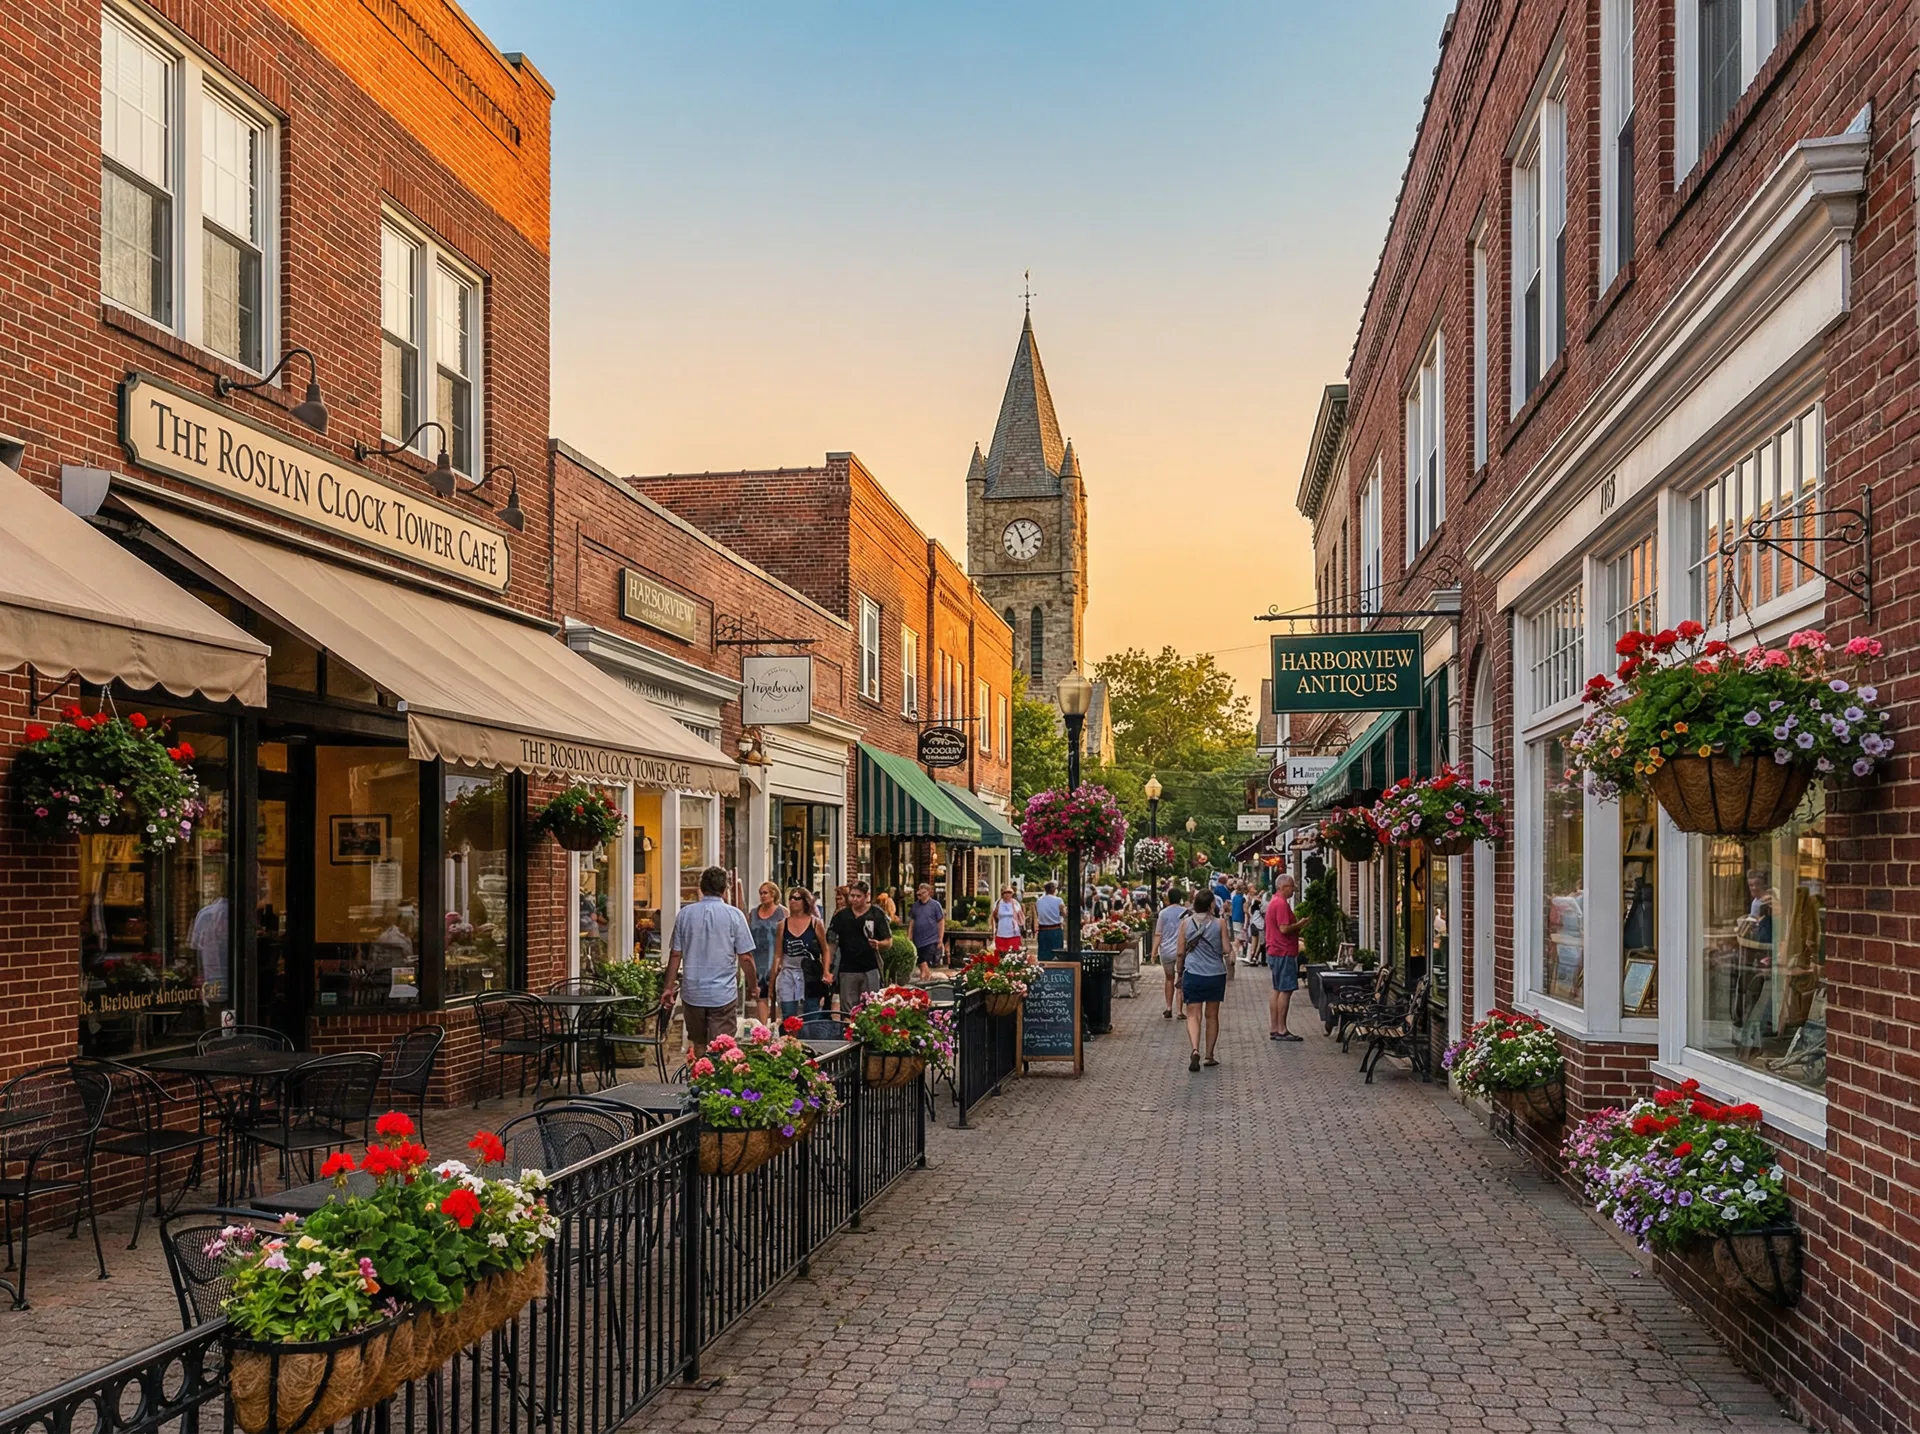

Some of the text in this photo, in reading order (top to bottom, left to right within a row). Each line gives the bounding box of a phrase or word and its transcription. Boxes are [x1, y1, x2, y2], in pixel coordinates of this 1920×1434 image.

[150, 399, 497, 575] THE ROSLYN CLOCK TOWER CAFÉ
[1281, 649, 1415, 671] HARBORVIEW
[1296, 673, 1398, 697] ANTIQUES
[520, 738, 547, 765] THE
[550, 742, 596, 772] ROSLYN
[597, 751, 634, 778] CLOCK
[634, 757, 669, 783] TOWER
